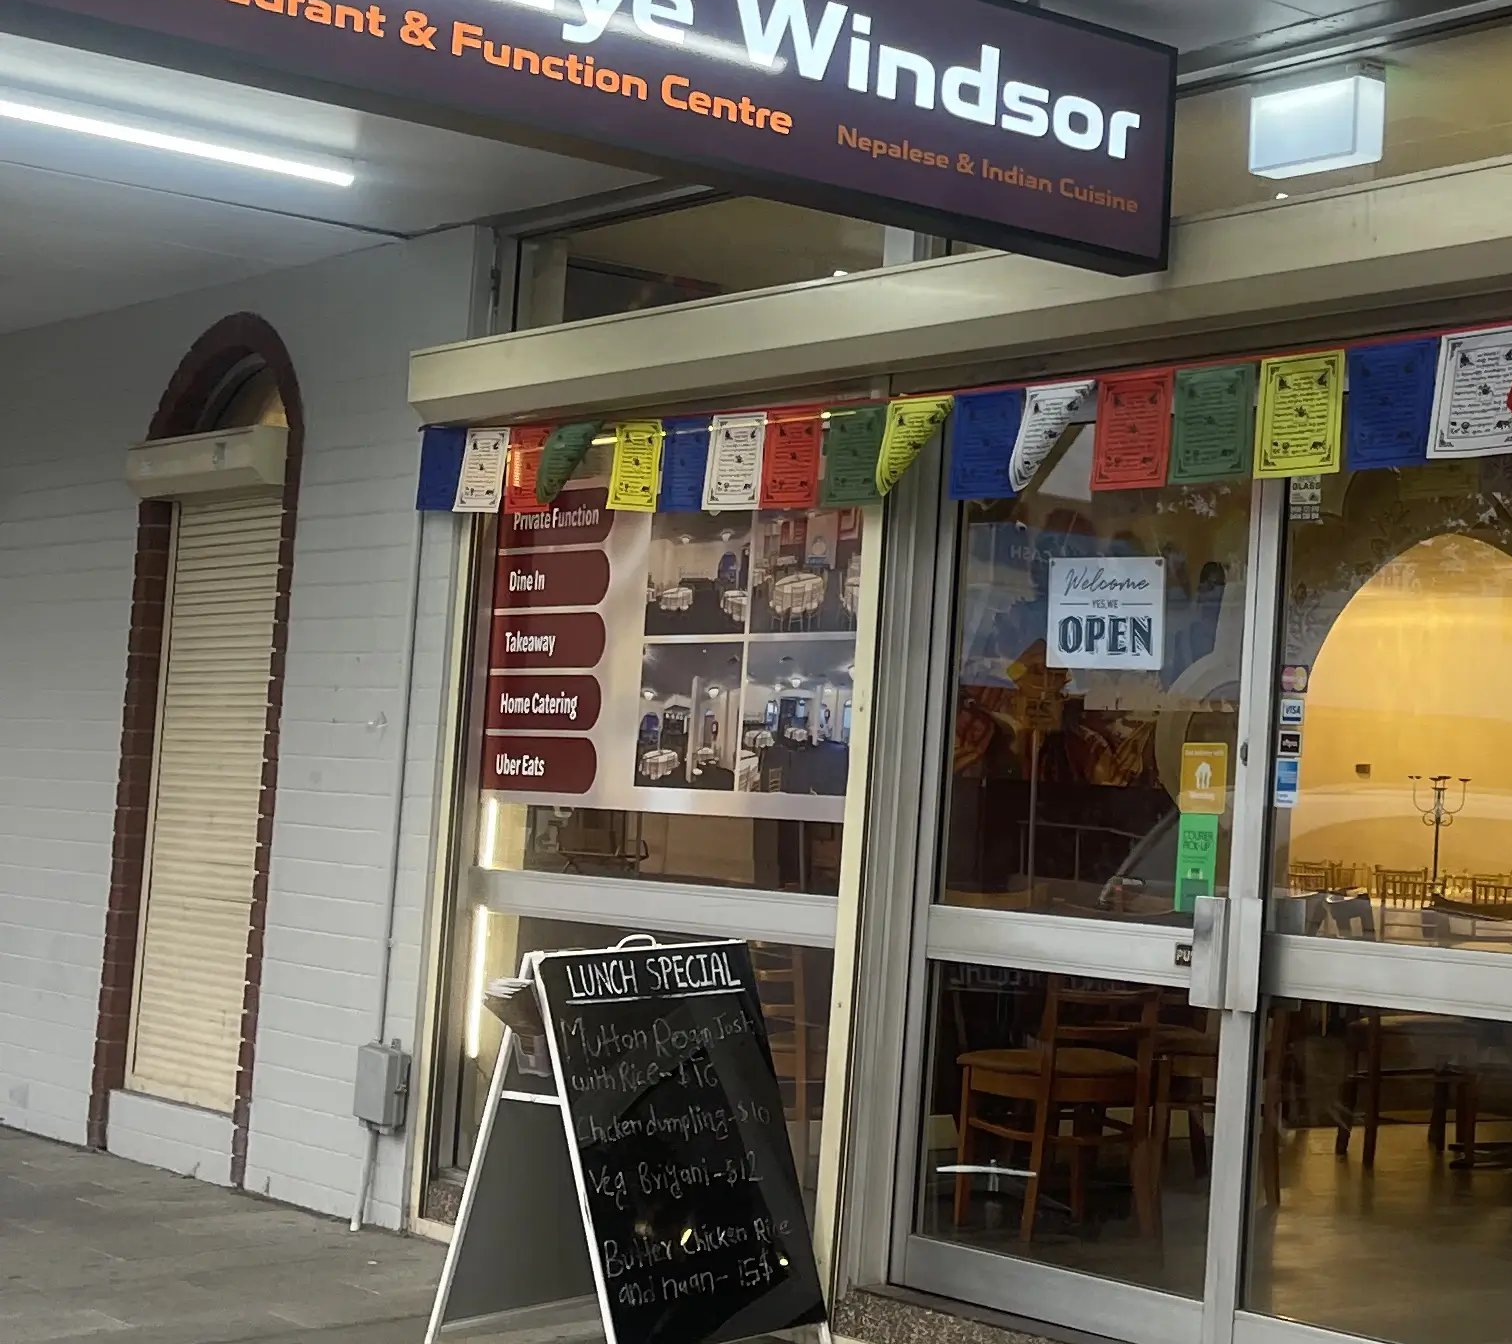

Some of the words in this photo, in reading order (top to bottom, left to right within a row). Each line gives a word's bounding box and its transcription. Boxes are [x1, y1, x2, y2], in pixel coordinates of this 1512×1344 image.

[400, 10, 437, 51] &
[450, 20, 648, 100] Function
[660, 74, 794, 136] Centre
[836, 124, 950, 170] Nepalese
[956, 153, 975, 175] &
[981, 158, 1053, 194] Indian
[1058, 177, 1139, 214] Cuisine
[513, 506, 551, 531] Private
[552, 504, 600, 529] Function
[509, 570, 534, 592] Dine
[535, 569, 546, 590] In
[1064, 567, 1150, 597] Welcome
[504, 631, 556, 657] Takeaway
[1058, 614, 1153, 657] OPEN
[500, 692, 531, 714] Home
[531, 691, 579, 719] Catering
[1286, 705, 1301, 715] VISA
[496, 753, 522, 776] Uber
[521, 756, 546, 777] Eats
[566, 959, 639, 997] LUNCH
[646, 952, 742, 991] SPECIAL
[588, 1165, 628, 1211] Veg
